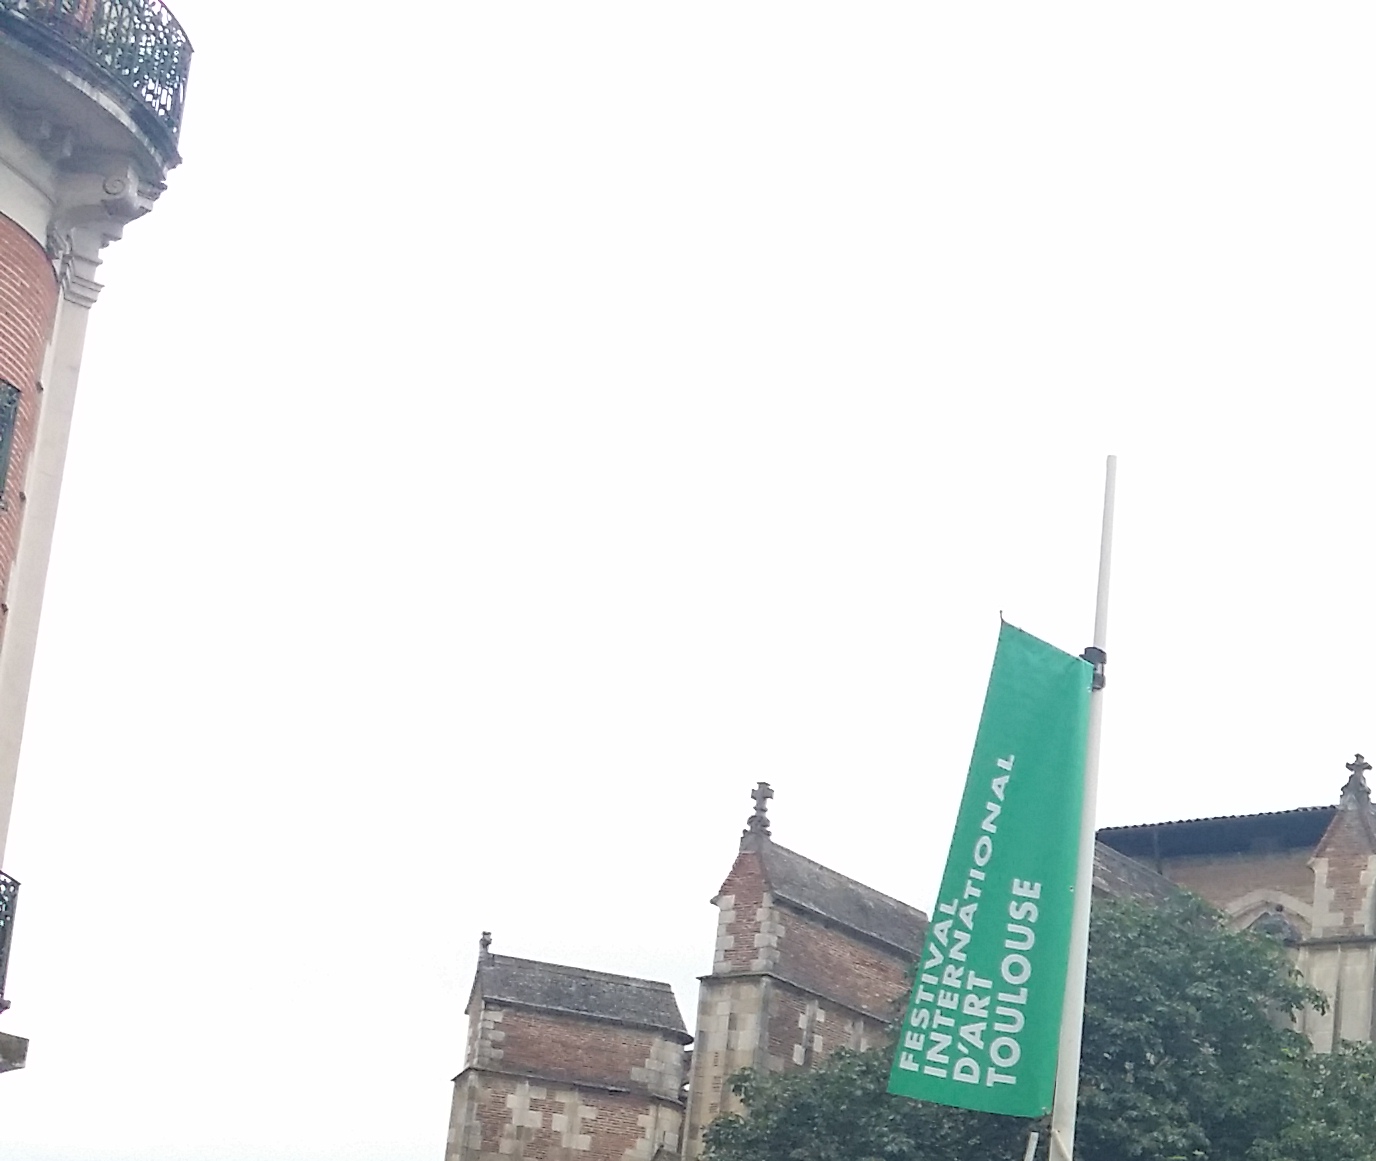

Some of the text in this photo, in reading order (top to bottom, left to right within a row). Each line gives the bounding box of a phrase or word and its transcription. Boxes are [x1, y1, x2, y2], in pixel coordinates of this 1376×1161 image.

[899, 898, 959, 1073] FESTIVAL
[923, 752, 1016, 1080] INTERNATIONAL
[986, 877, 1042, 1089] TOULOUSE
[952, 970, 993, 1086] D'ART
